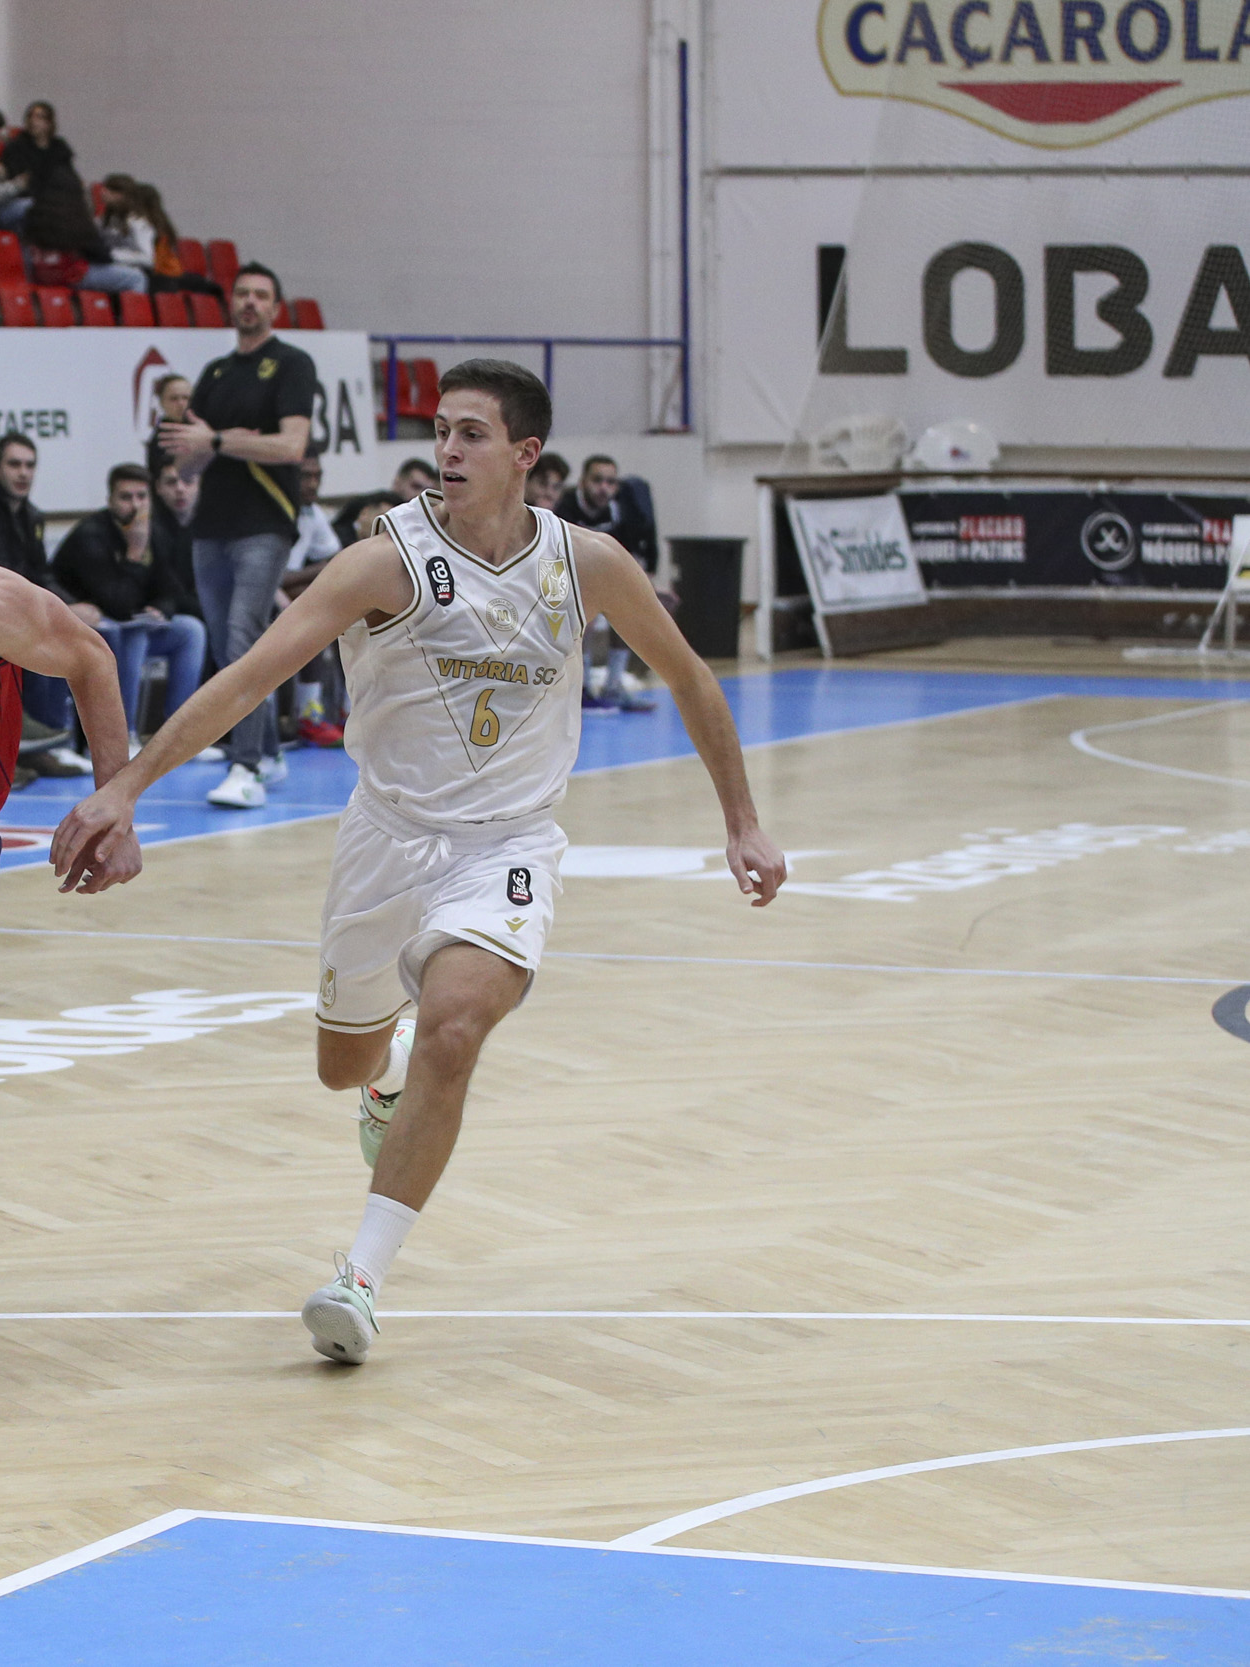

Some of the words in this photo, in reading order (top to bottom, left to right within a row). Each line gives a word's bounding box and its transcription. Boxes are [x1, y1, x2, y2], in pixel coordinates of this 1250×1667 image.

[816, 240, 1250, 378] LOBA
[437, 656, 528, 685] VITÓRIA
[533, 666, 557, 686] SC
[468, 688, 500, 747] 6
